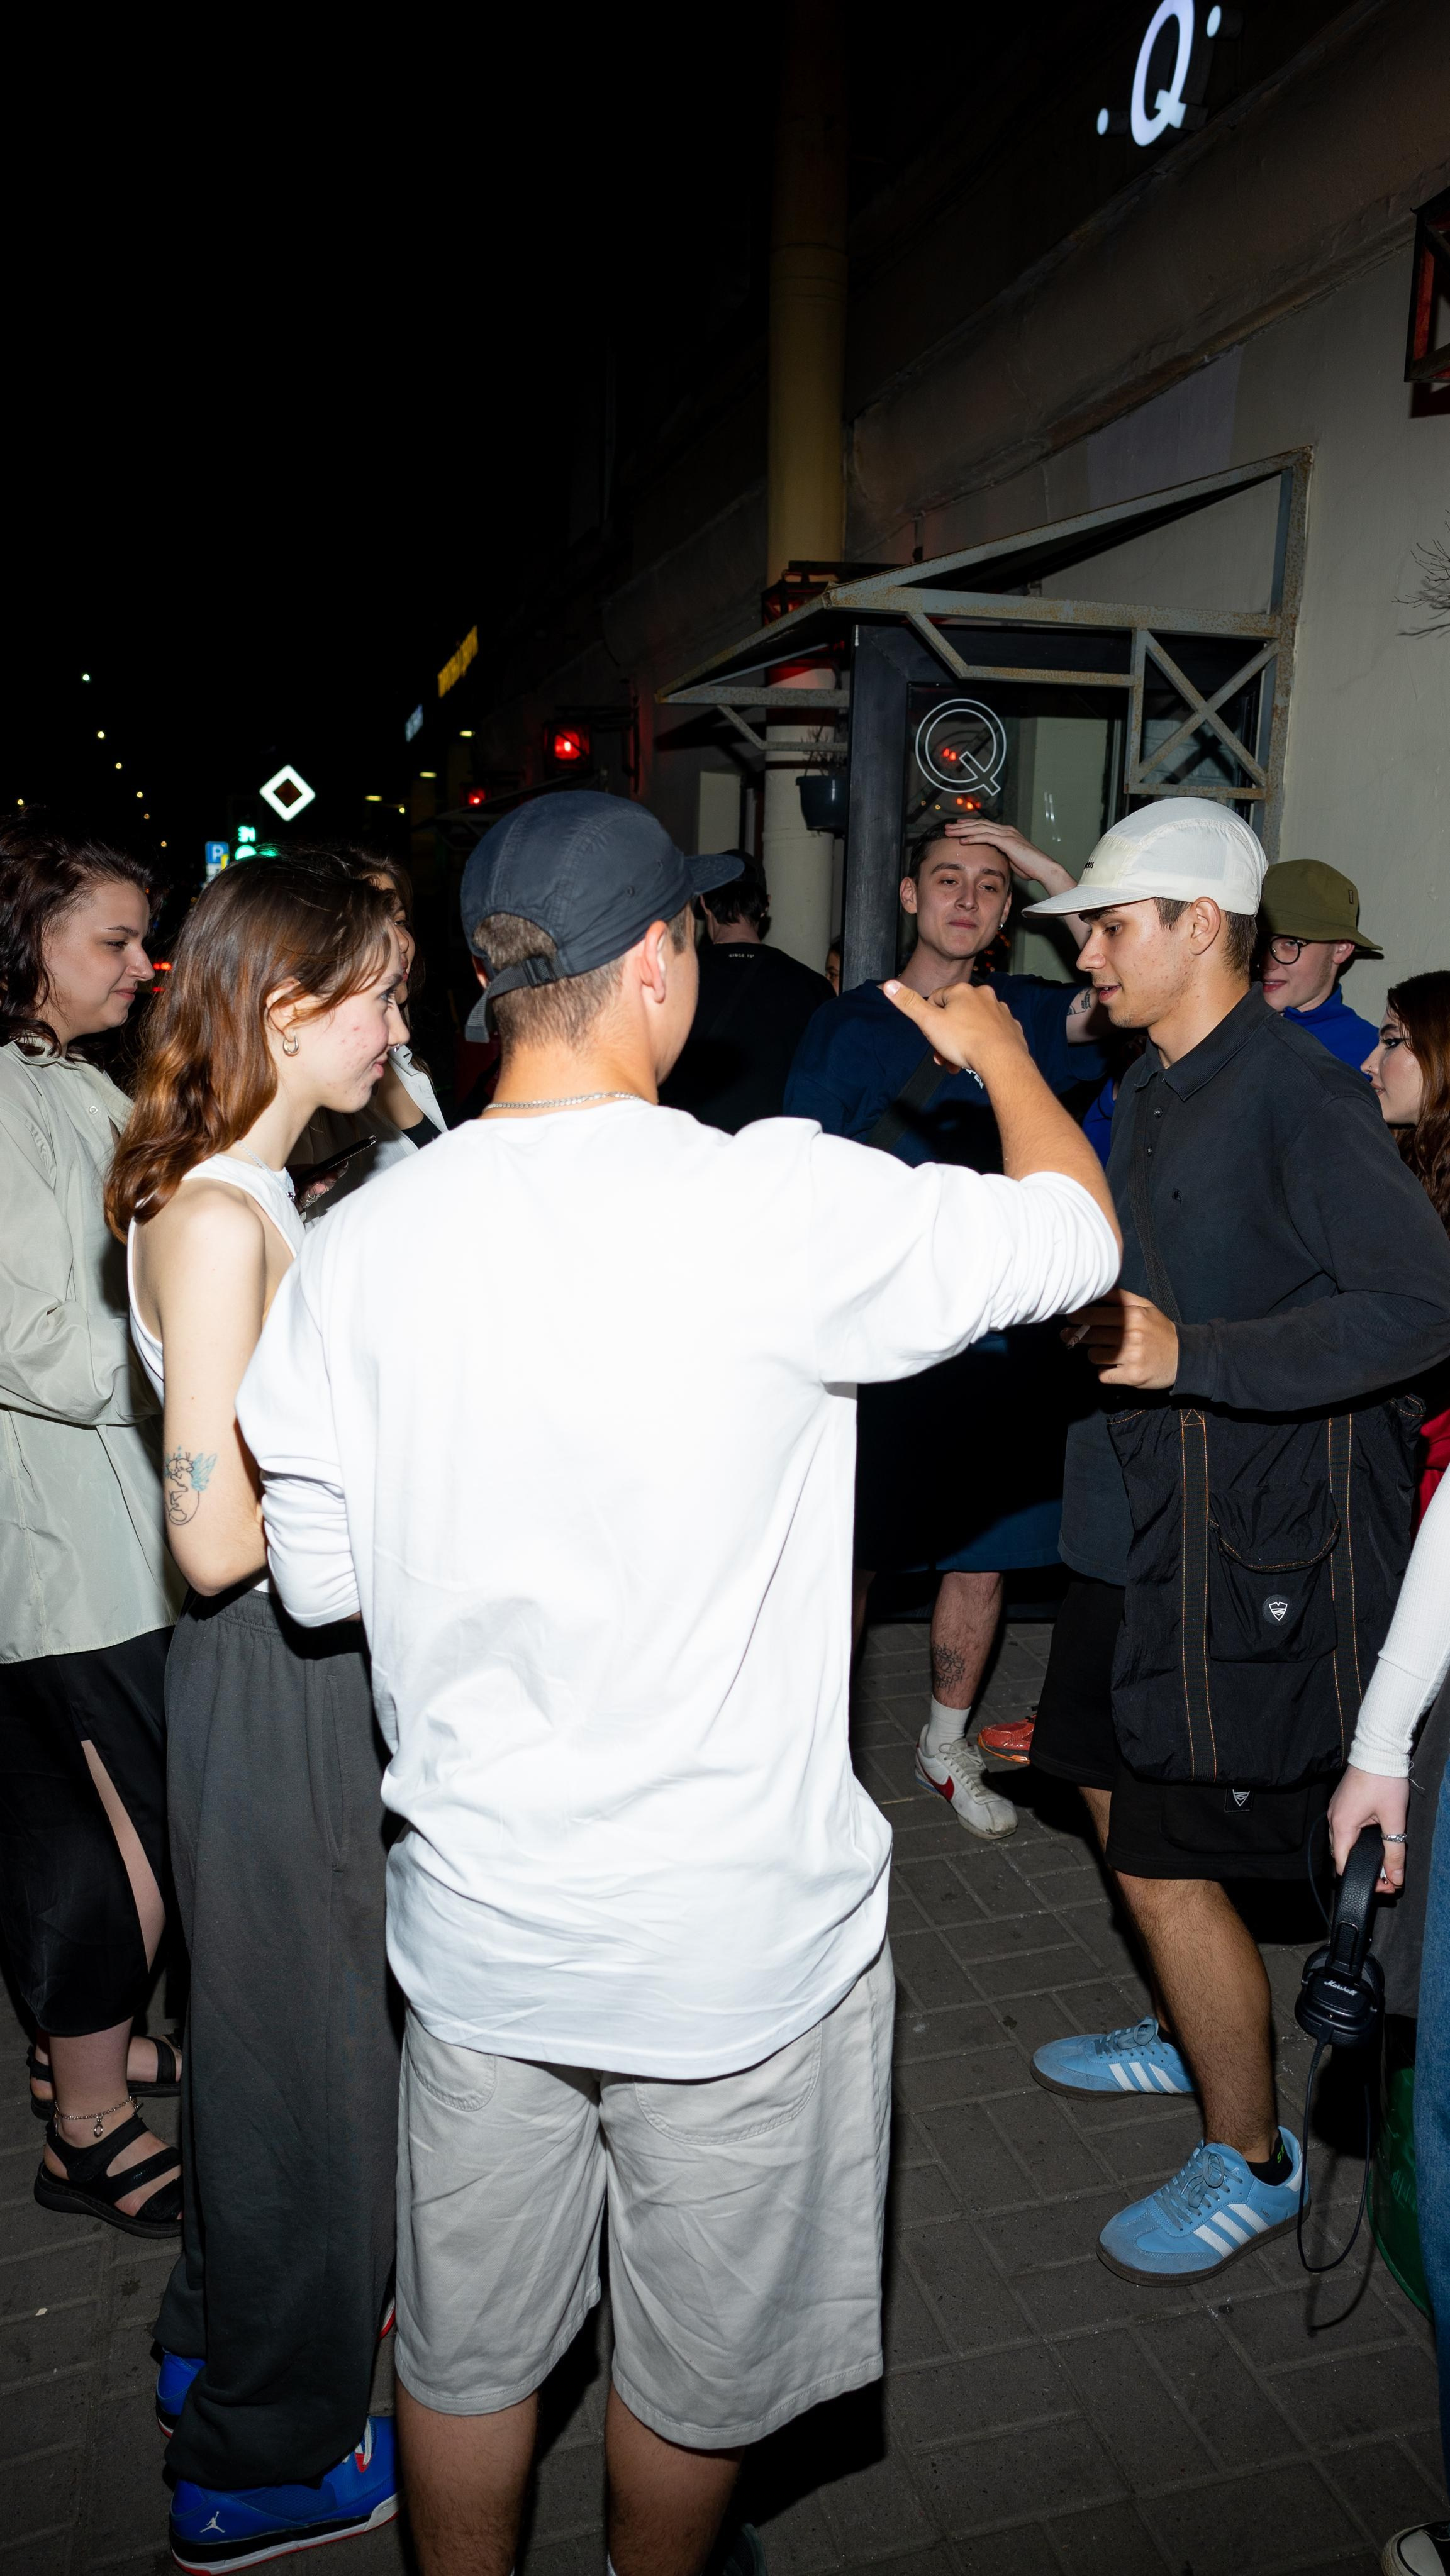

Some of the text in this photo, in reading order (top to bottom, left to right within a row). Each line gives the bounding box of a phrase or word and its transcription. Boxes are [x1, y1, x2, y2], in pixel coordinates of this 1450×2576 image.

[1131, 0, 1194, 147] Q
[915, 699, 1007, 796] Q
[213, 844, 224, 862] P
[1324, 1980, 1358, 1996] Marshall
